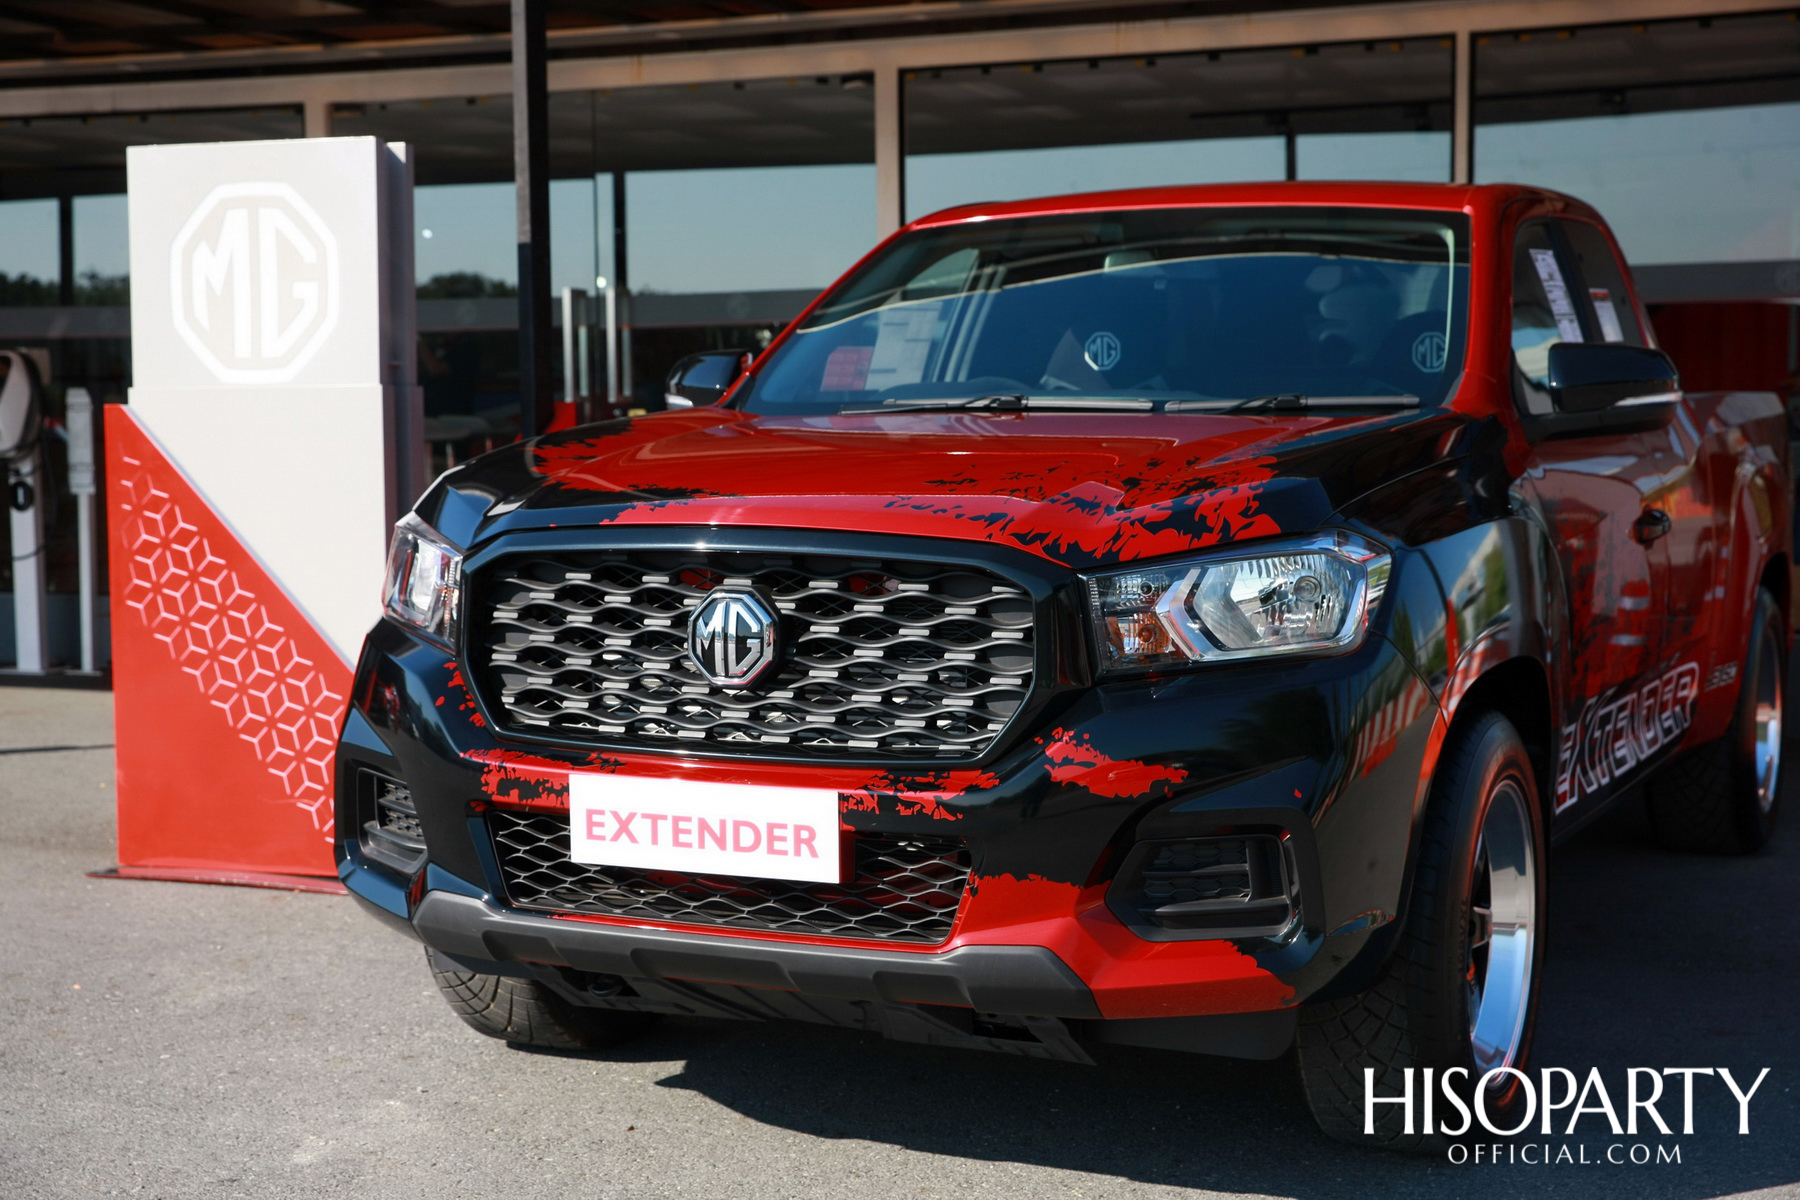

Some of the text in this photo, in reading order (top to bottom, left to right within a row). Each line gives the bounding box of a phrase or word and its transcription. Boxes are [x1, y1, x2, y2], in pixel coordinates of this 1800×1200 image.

[191, 206, 319, 359] MG
[1089, 335, 1116, 367] MG
[1417, 336, 1446, 368] MG
[695, 600, 761, 677] MG
[1555, 661, 1700, 815] EXTENDER
[585, 808, 820, 858] EXTENDER
